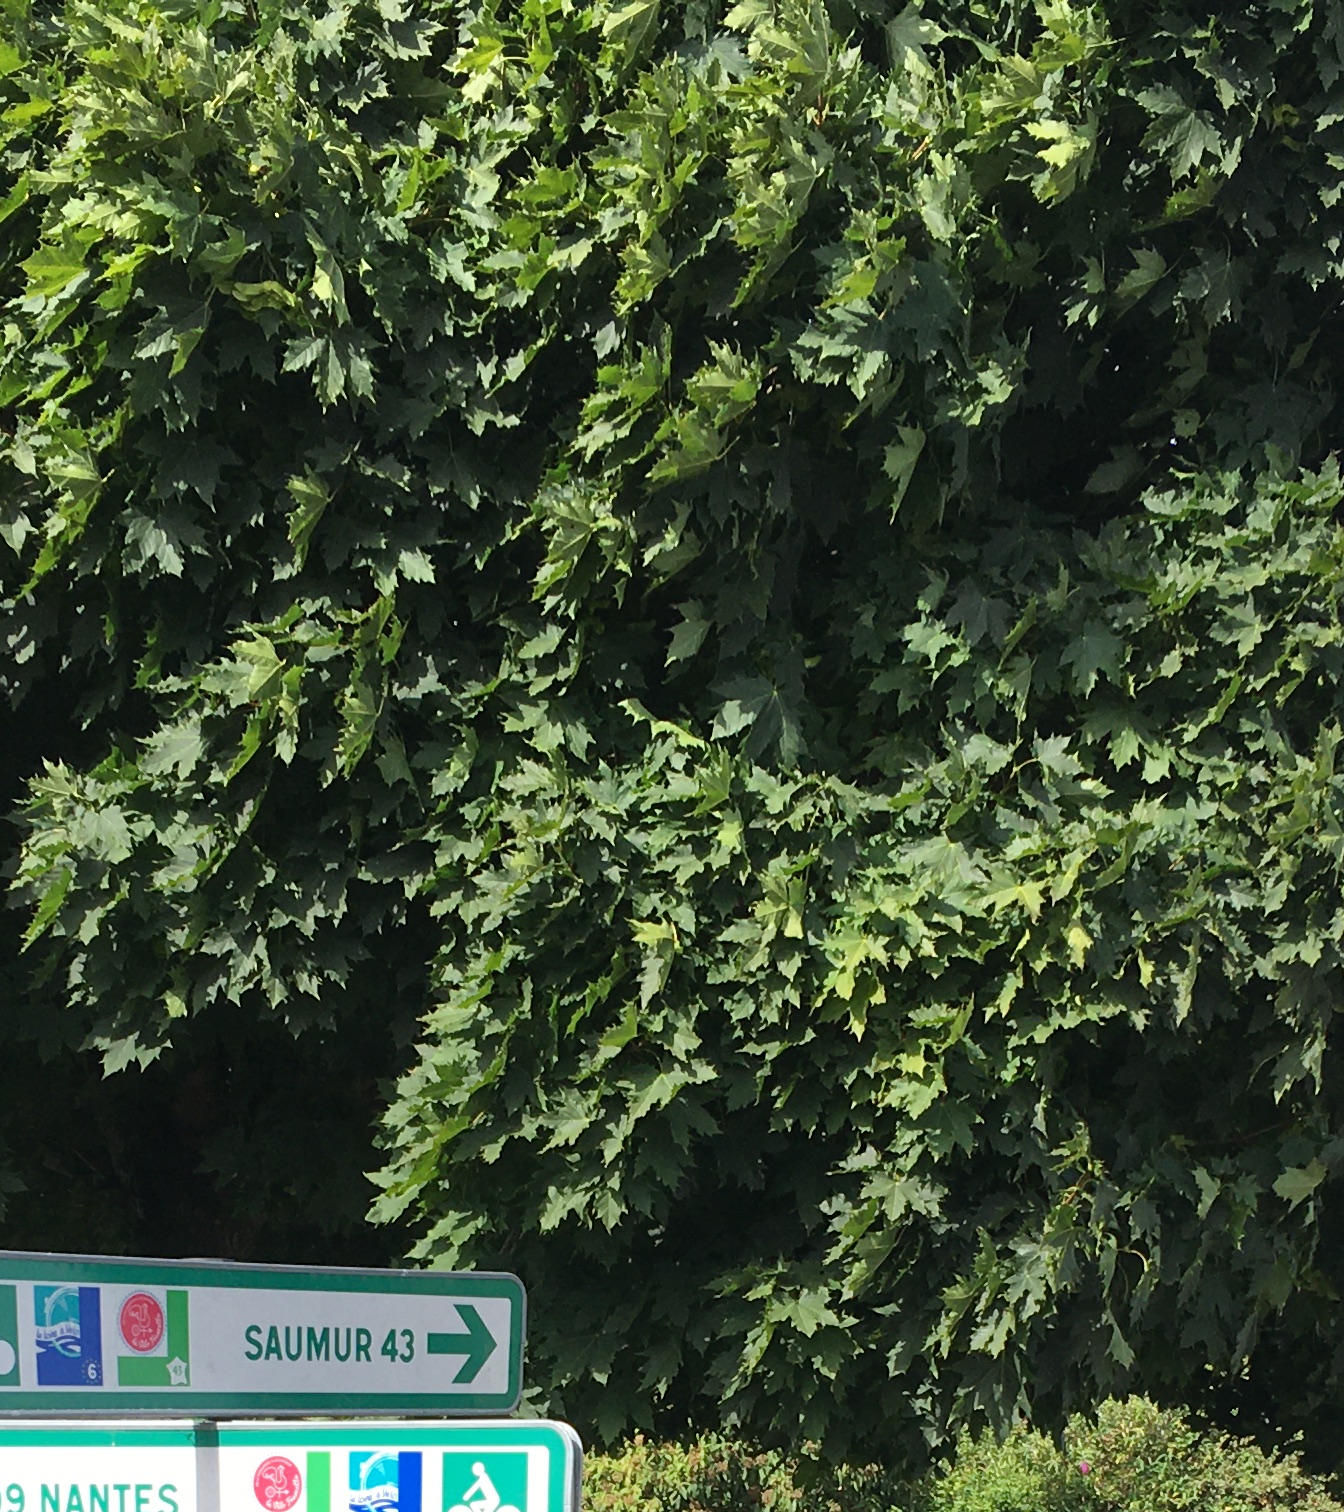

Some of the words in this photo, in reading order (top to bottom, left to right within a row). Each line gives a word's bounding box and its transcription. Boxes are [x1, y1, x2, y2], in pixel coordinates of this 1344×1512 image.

[244, 1324, 372, 1362] SAUMUR
[381, 1328, 415, 1363] 43
[87, 1363, 97, 1380] 6
